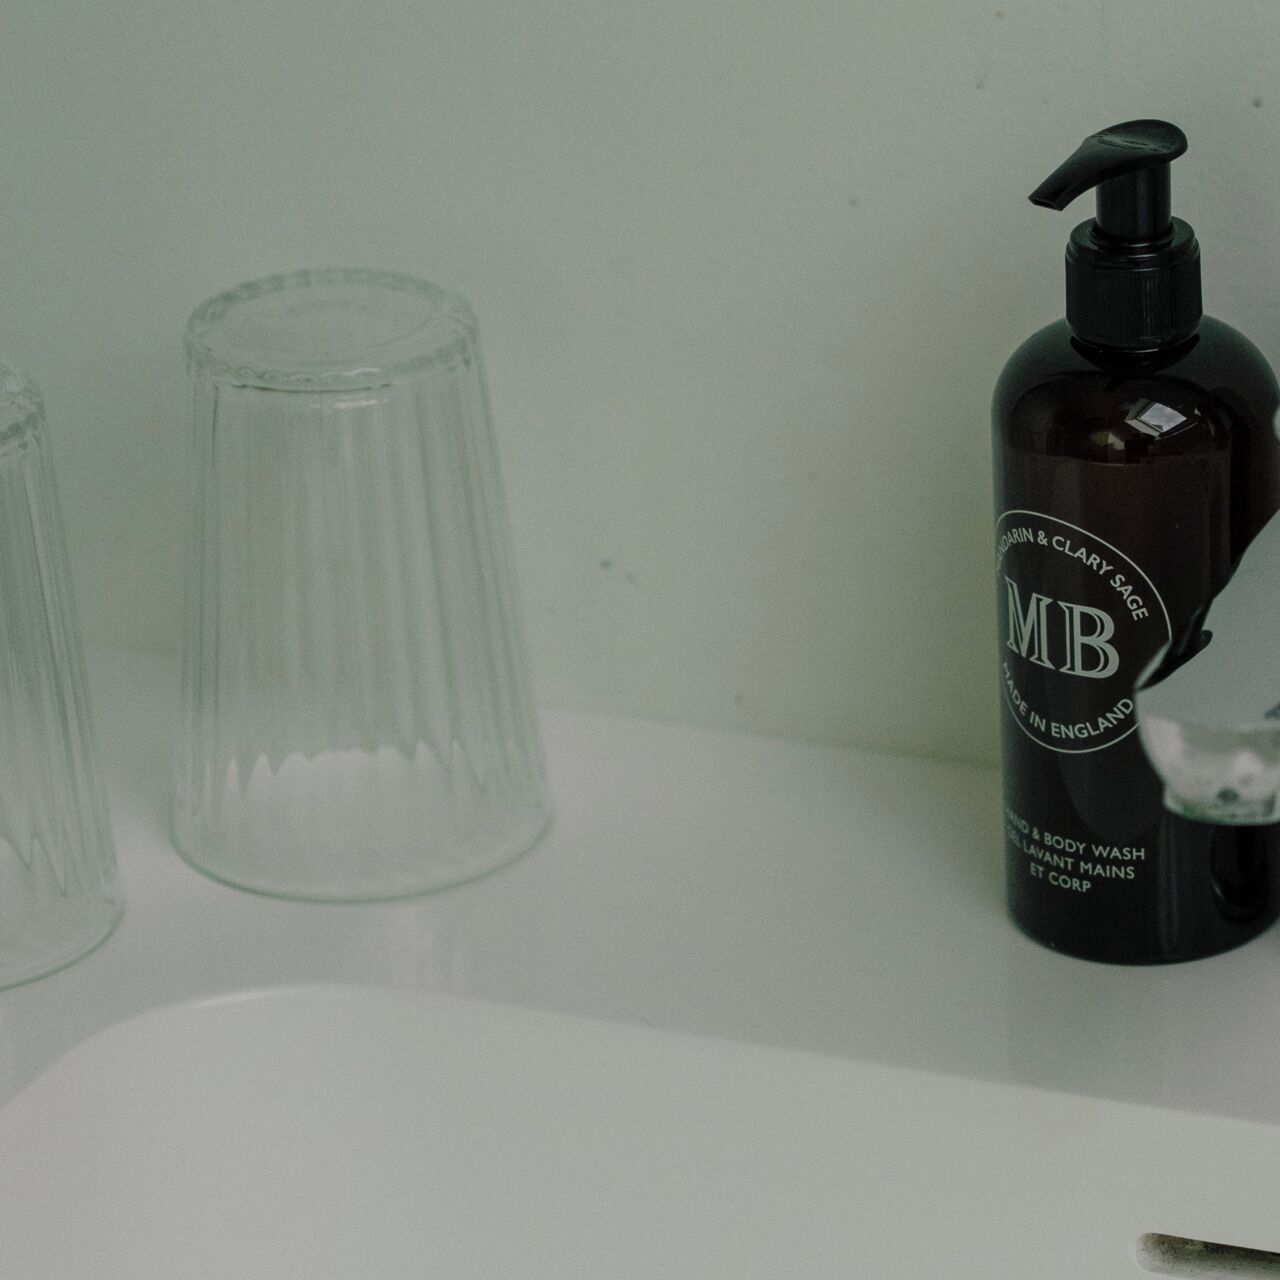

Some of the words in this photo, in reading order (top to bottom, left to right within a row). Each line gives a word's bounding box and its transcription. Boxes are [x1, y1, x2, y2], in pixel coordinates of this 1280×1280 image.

[1037, 530, 1048, 546] &
[1052, 535, 1114, 575] CLARY
[1110, 573, 1149, 622] SAGE
[1004, 576, 1120, 680] MB
[1030, 711, 1046, 733] IN
[1050, 698, 1135, 739] ENGLAND
[1023, 839, 1075, 871] LAVANT
[1079, 860, 1135, 880] MAINS
[1032, 827, 1040, 841] &
[1044, 831, 1087, 855] BODY
[1092, 844, 1145, 861] WASH
[1029, 861, 1045, 879] ET
[1048, 871, 1092, 893] CORP
